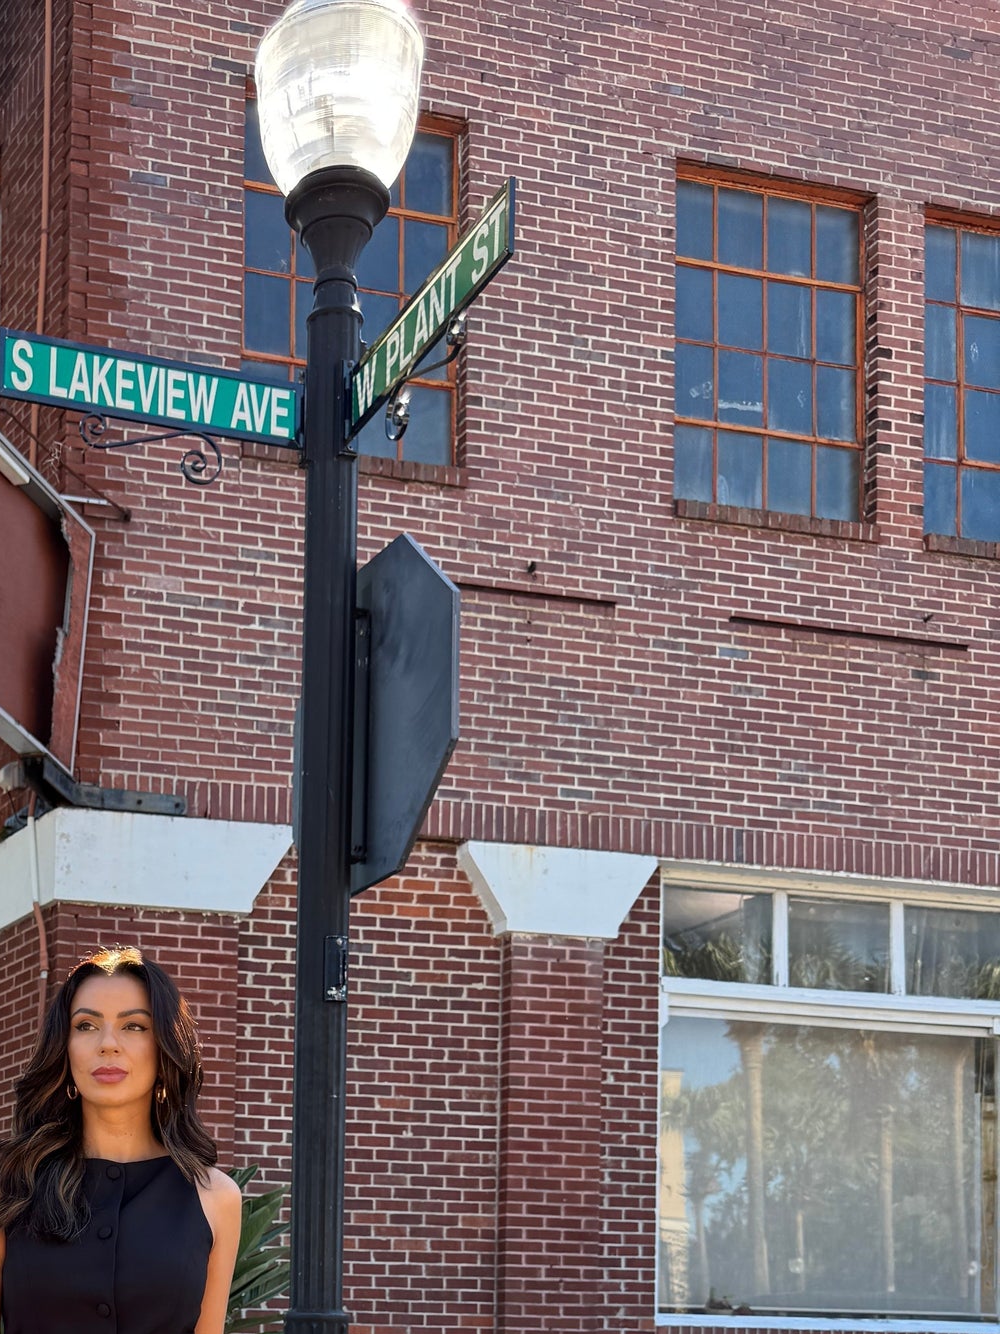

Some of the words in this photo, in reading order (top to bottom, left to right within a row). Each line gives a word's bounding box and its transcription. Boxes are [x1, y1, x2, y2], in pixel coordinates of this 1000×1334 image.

[354, 352, 378, 416] W
[385, 253, 463, 387] PLANT
[471, 201, 507, 285] ST
[10, 339, 34, 392] S
[48, 346, 219, 425] LAKEVIEW
[230, 382, 291, 438] AVE
